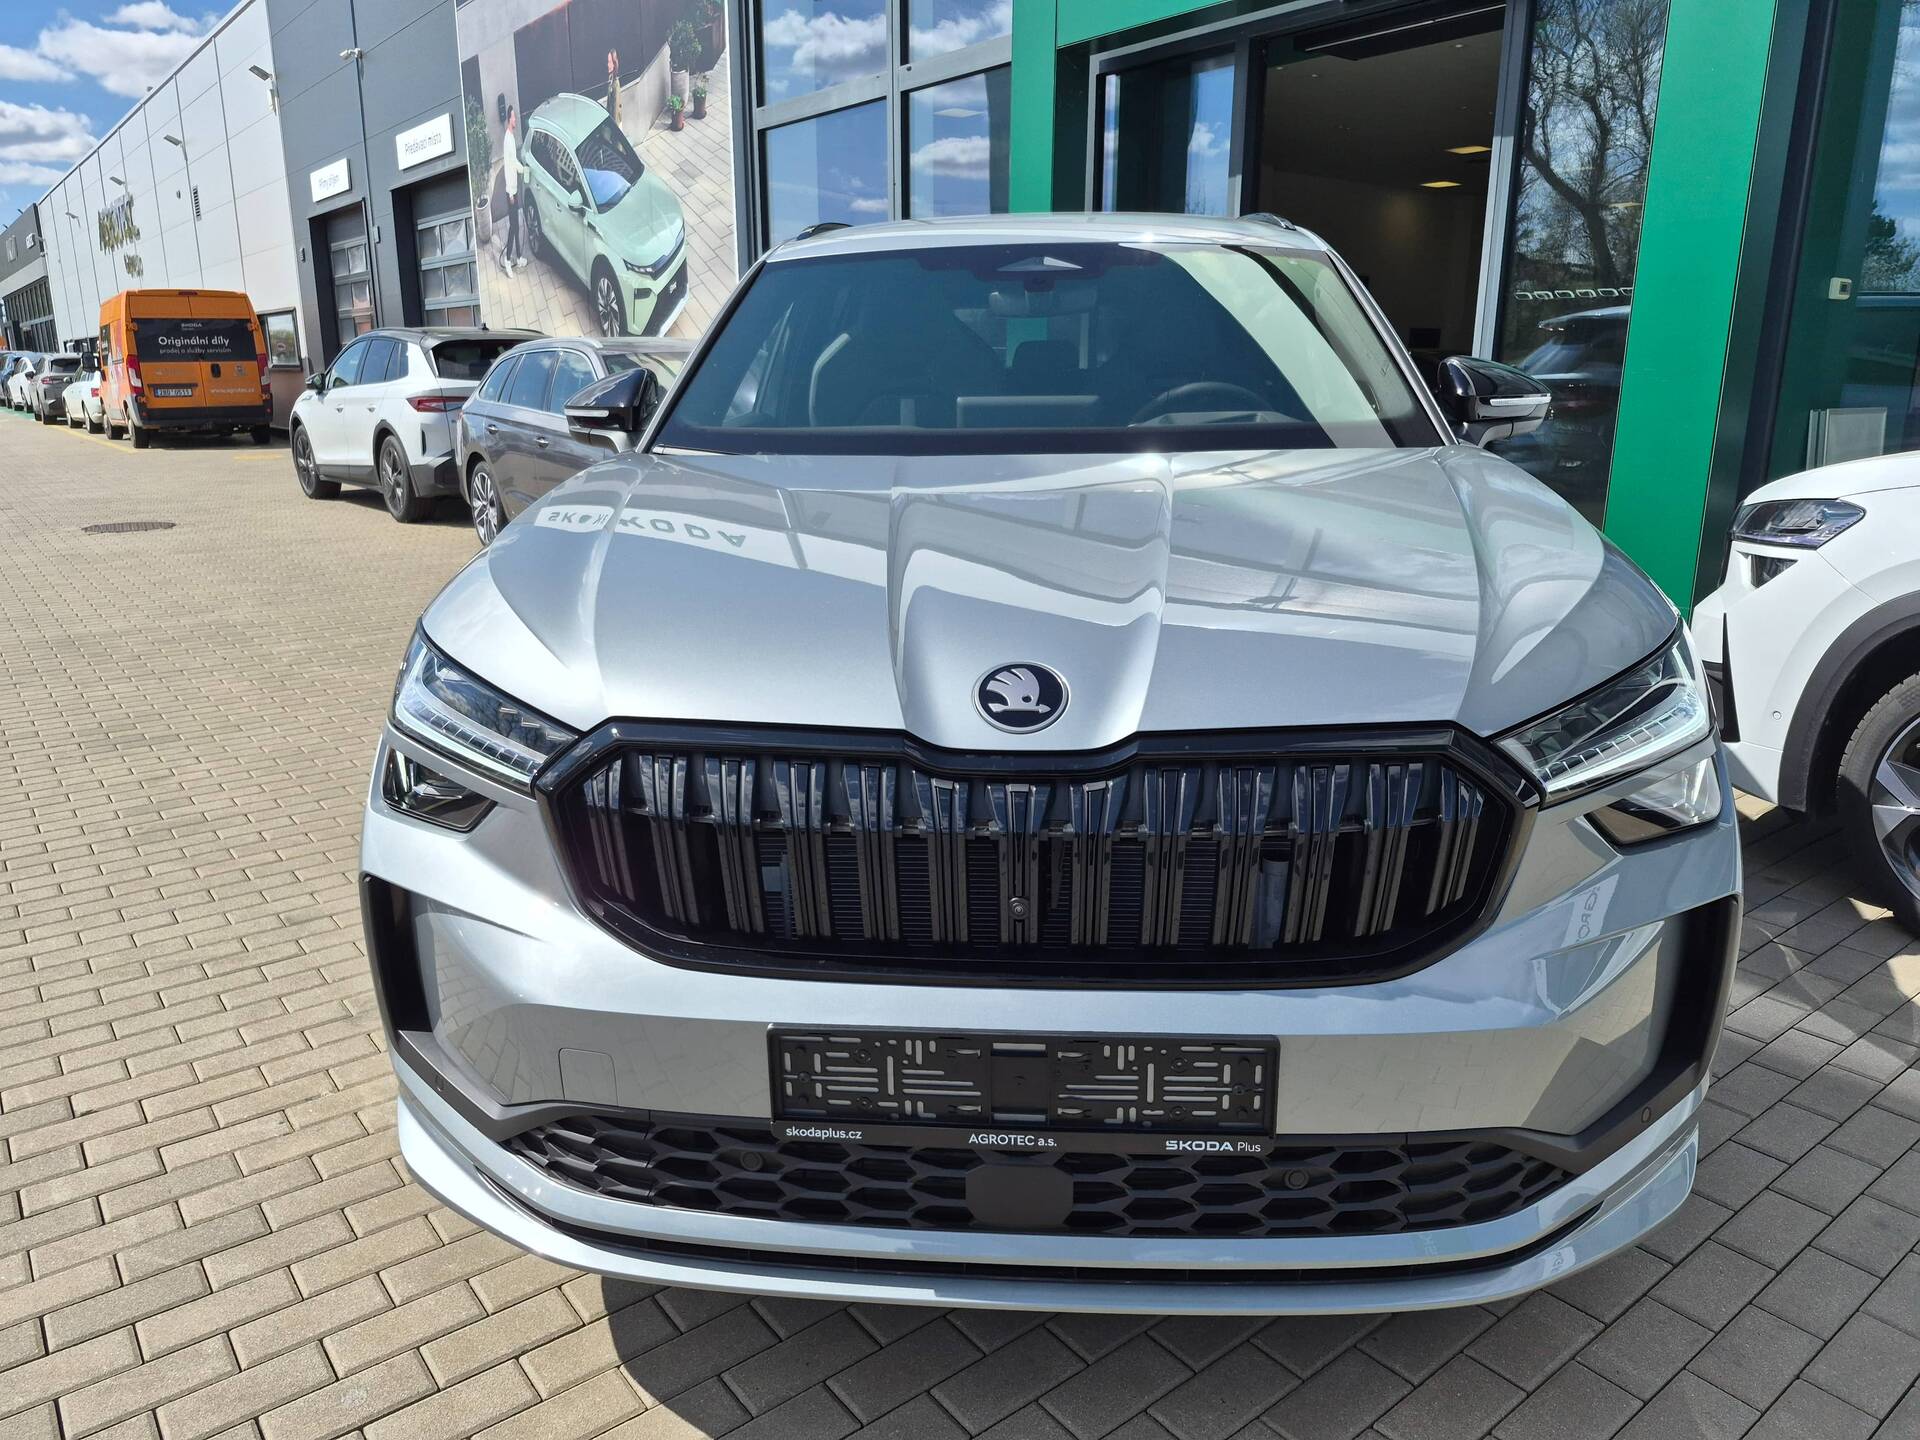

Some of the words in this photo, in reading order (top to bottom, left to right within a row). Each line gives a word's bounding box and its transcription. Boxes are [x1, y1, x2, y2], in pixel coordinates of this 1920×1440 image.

[158, 335, 209, 347] Originální
[211, 335, 230, 347] díly
[785, 1125, 863, 1140] skodaplus.cz
[968, 1133, 1035, 1146] AGROTEC
[1037, 1137, 1057, 1147] a.s.
[1237, 1141, 1261, 1152] Plus
